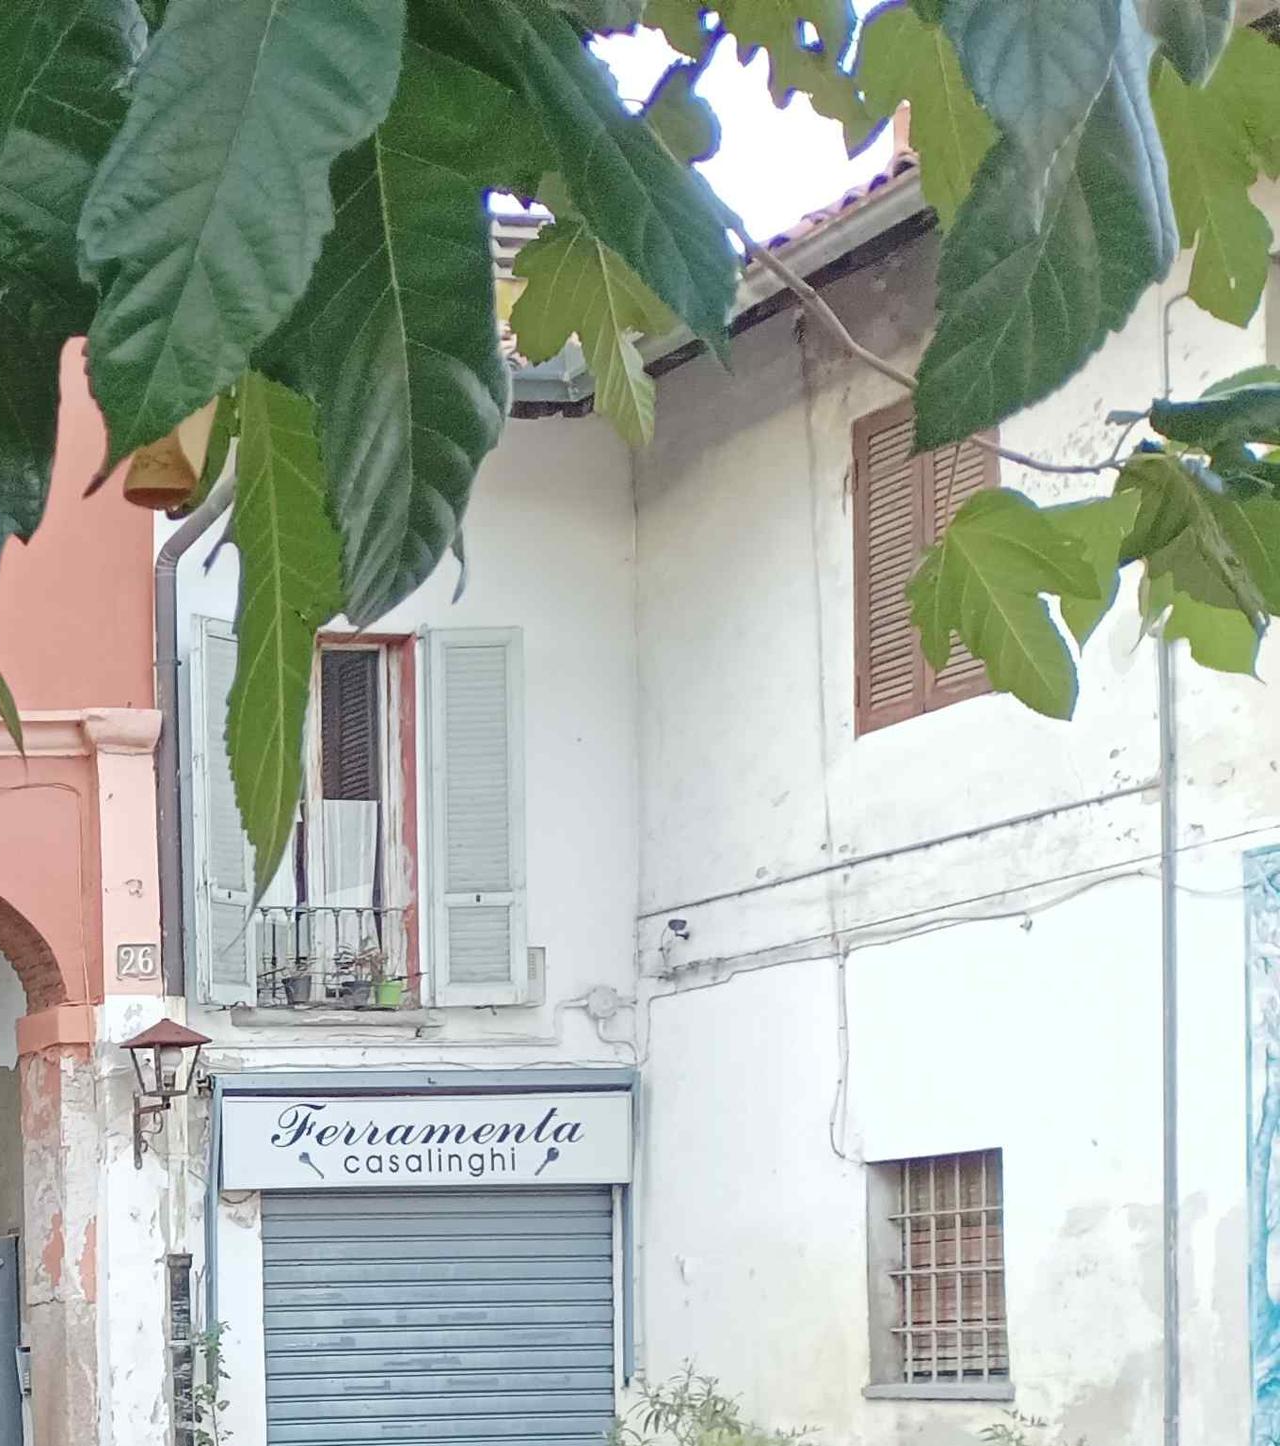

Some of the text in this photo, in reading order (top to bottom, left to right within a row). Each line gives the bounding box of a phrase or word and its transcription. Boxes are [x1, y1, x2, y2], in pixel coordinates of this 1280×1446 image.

[120, 946, 154, 976] 26
[270, 1103, 585, 1148] Ferramenta
[343, 1148, 518, 1178] casalinghi
